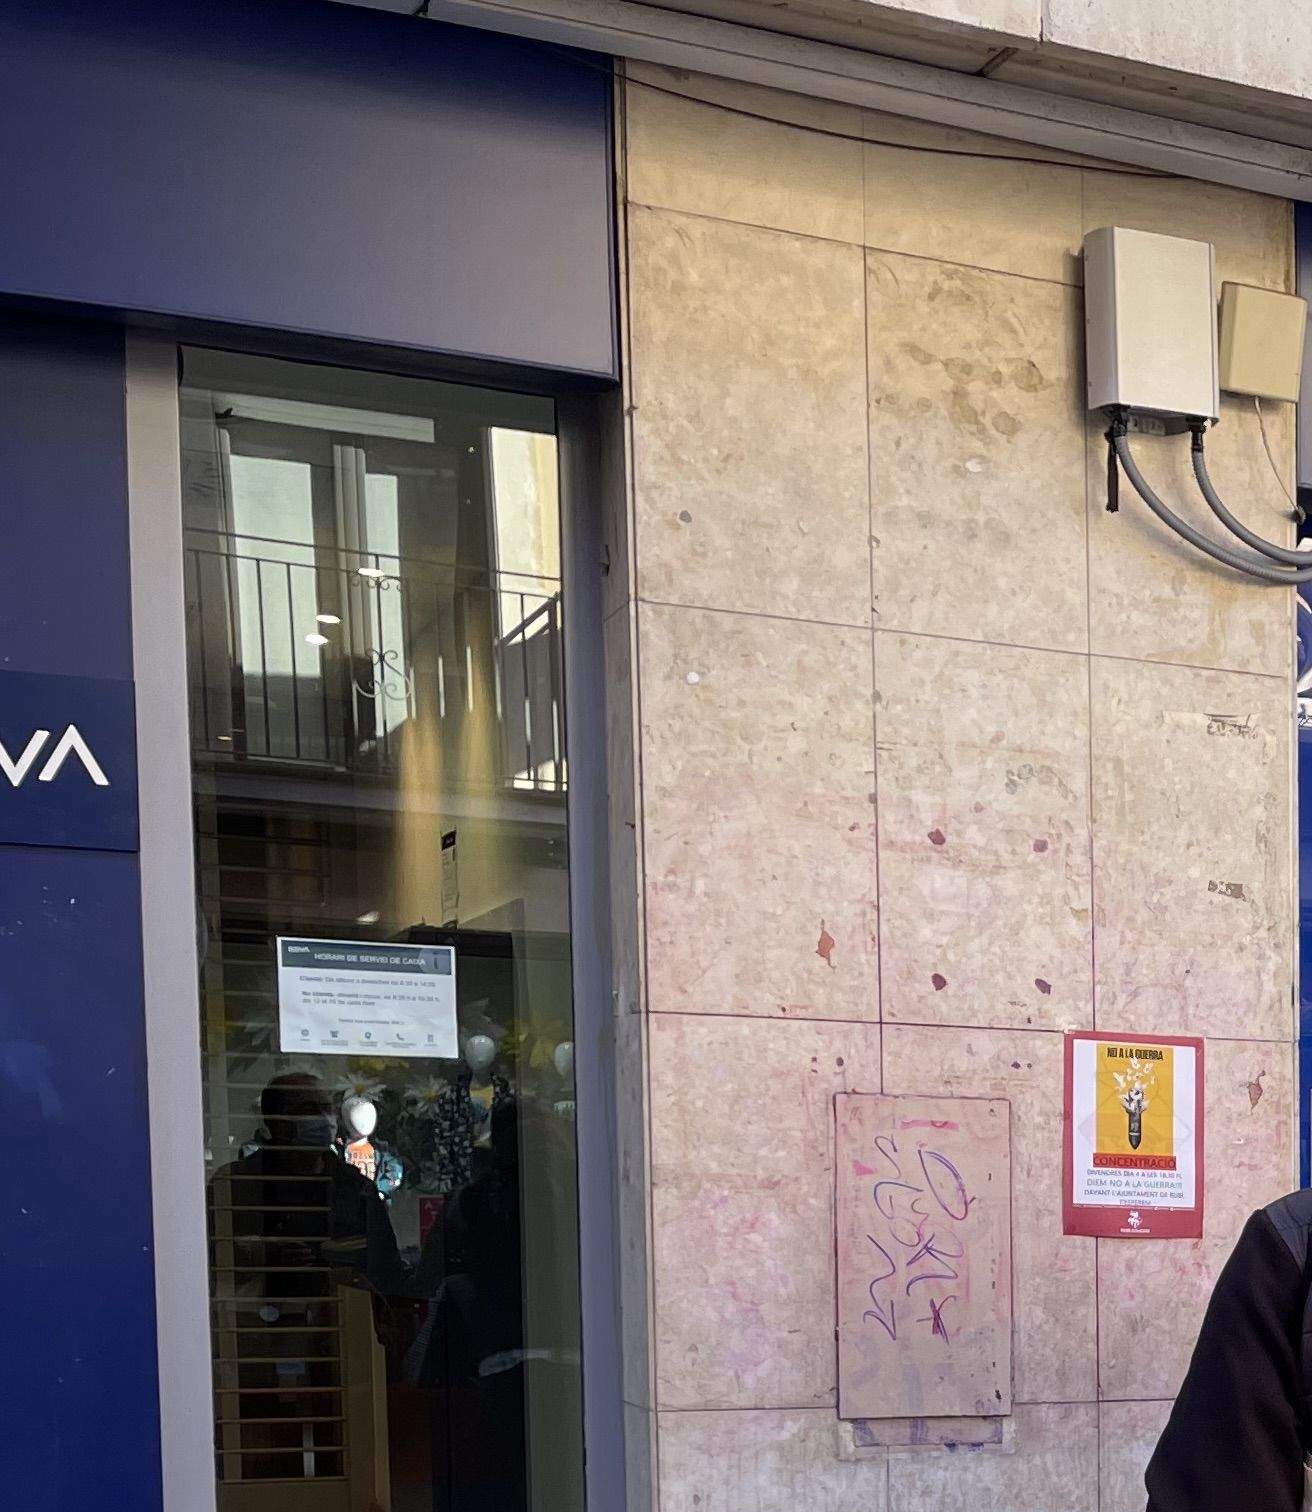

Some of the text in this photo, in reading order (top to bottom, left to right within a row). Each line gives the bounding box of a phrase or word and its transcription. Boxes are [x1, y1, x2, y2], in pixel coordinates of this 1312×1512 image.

[1107, 1047, 1117, 1058] NO
[1119, 1048, 1124, 1058] A
[1125, 1048, 1134, 1059] LA
